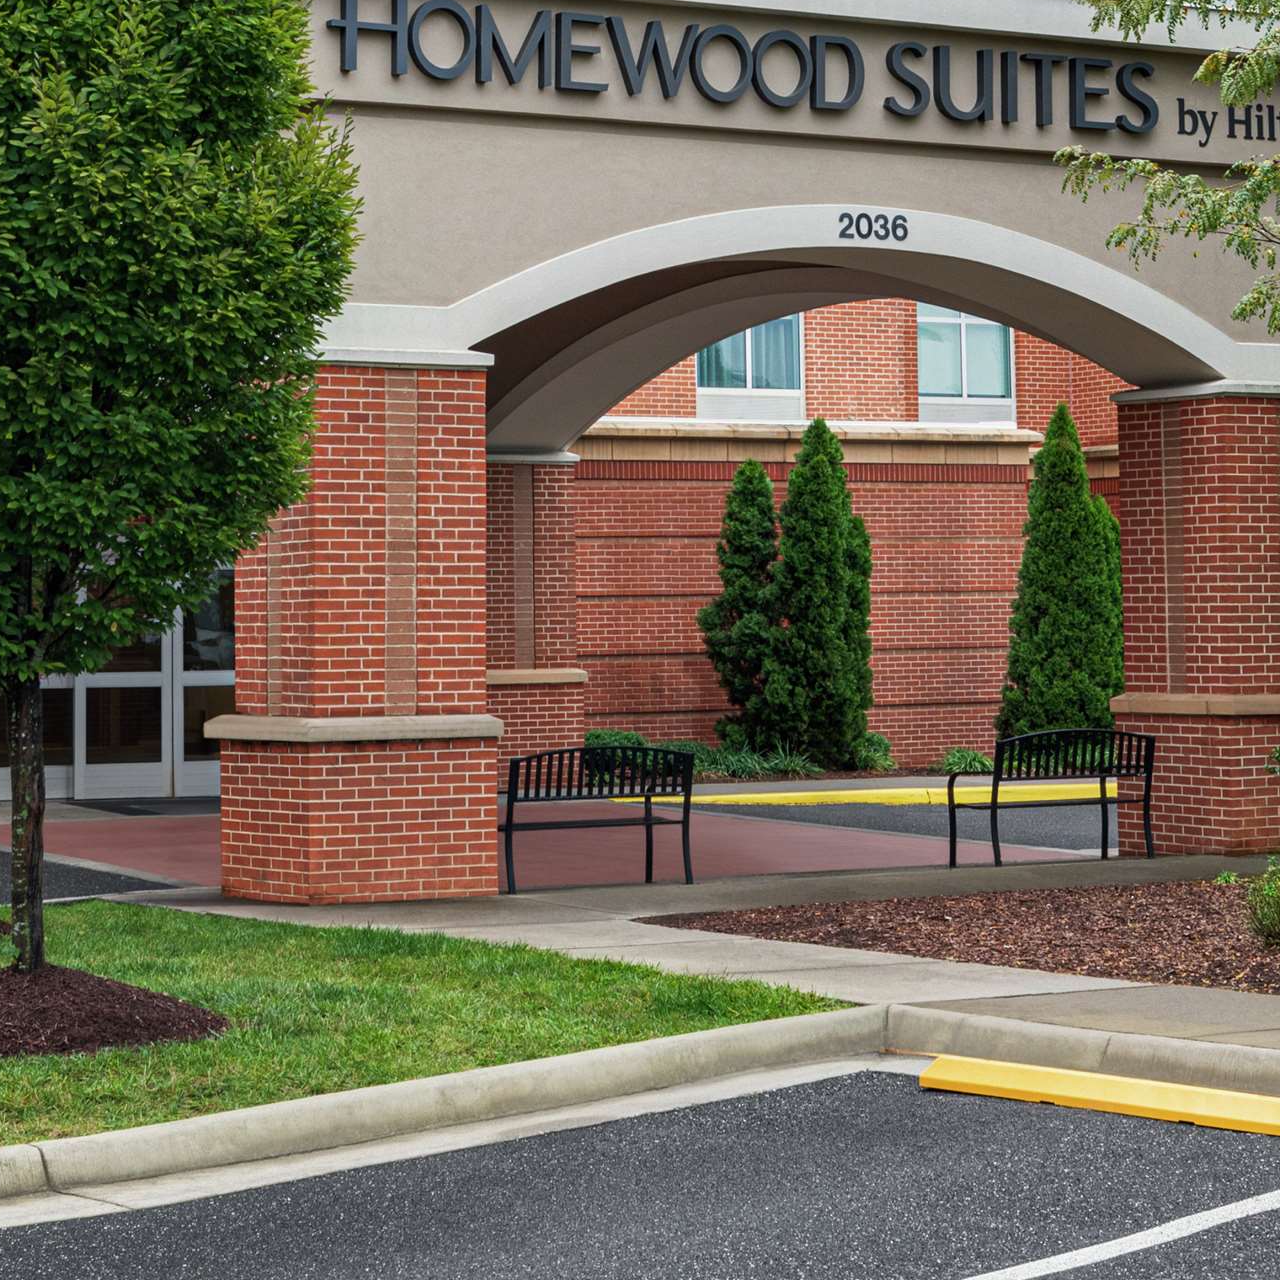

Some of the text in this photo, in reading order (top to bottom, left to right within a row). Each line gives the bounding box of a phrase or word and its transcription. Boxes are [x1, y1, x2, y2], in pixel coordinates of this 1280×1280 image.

[883, 41, 1159, 134] SUITES
[1177, 97, 1216, 147] by
[838, 212, 909, 242] 2036
